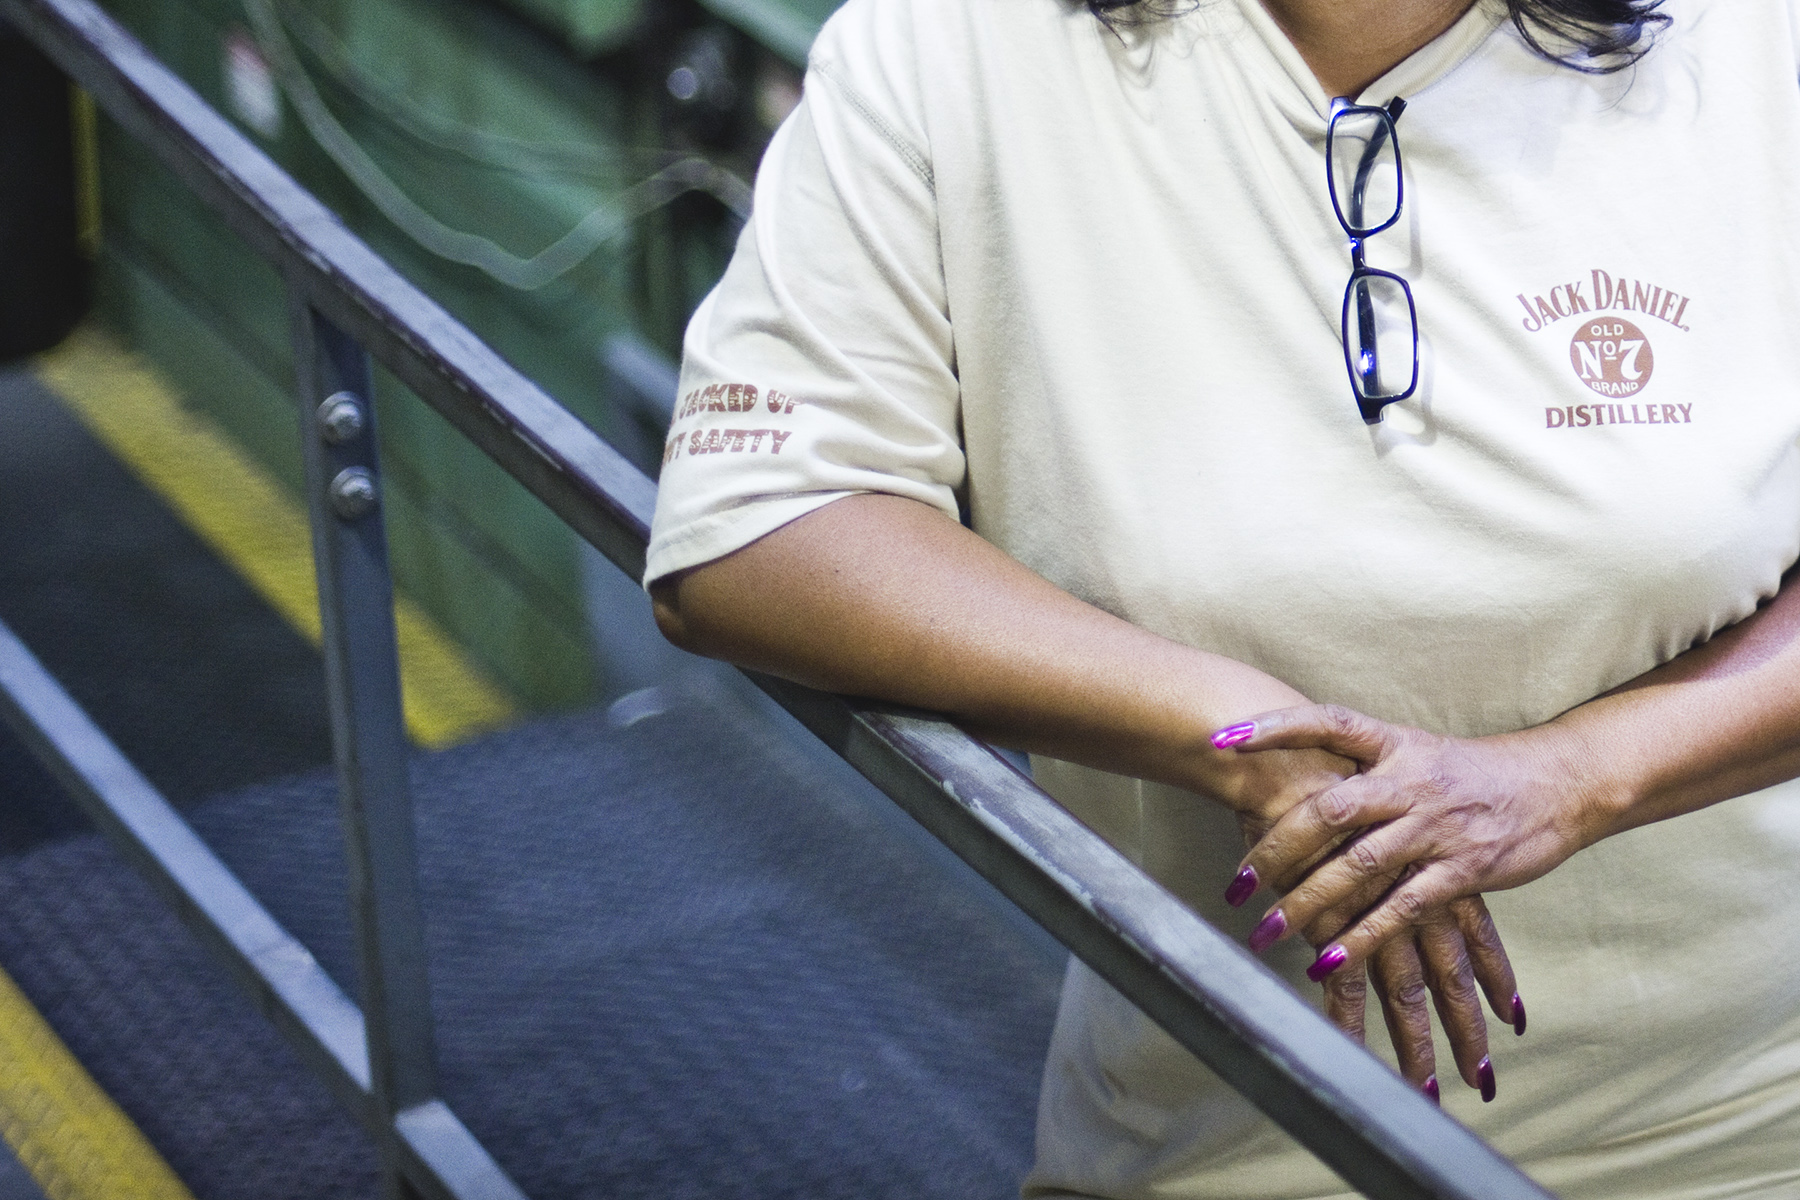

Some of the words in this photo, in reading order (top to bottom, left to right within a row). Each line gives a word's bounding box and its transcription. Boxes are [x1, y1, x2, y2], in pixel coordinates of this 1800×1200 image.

[1516, 281, 1590, 332] JACK
[1591, 324, 1624, 337] OLD
[1591, 381, 1639, 396] BRAND
[1545, 402, 1693, 429] DISTILLERY
[688, 428, 792, 456] SAFETY
